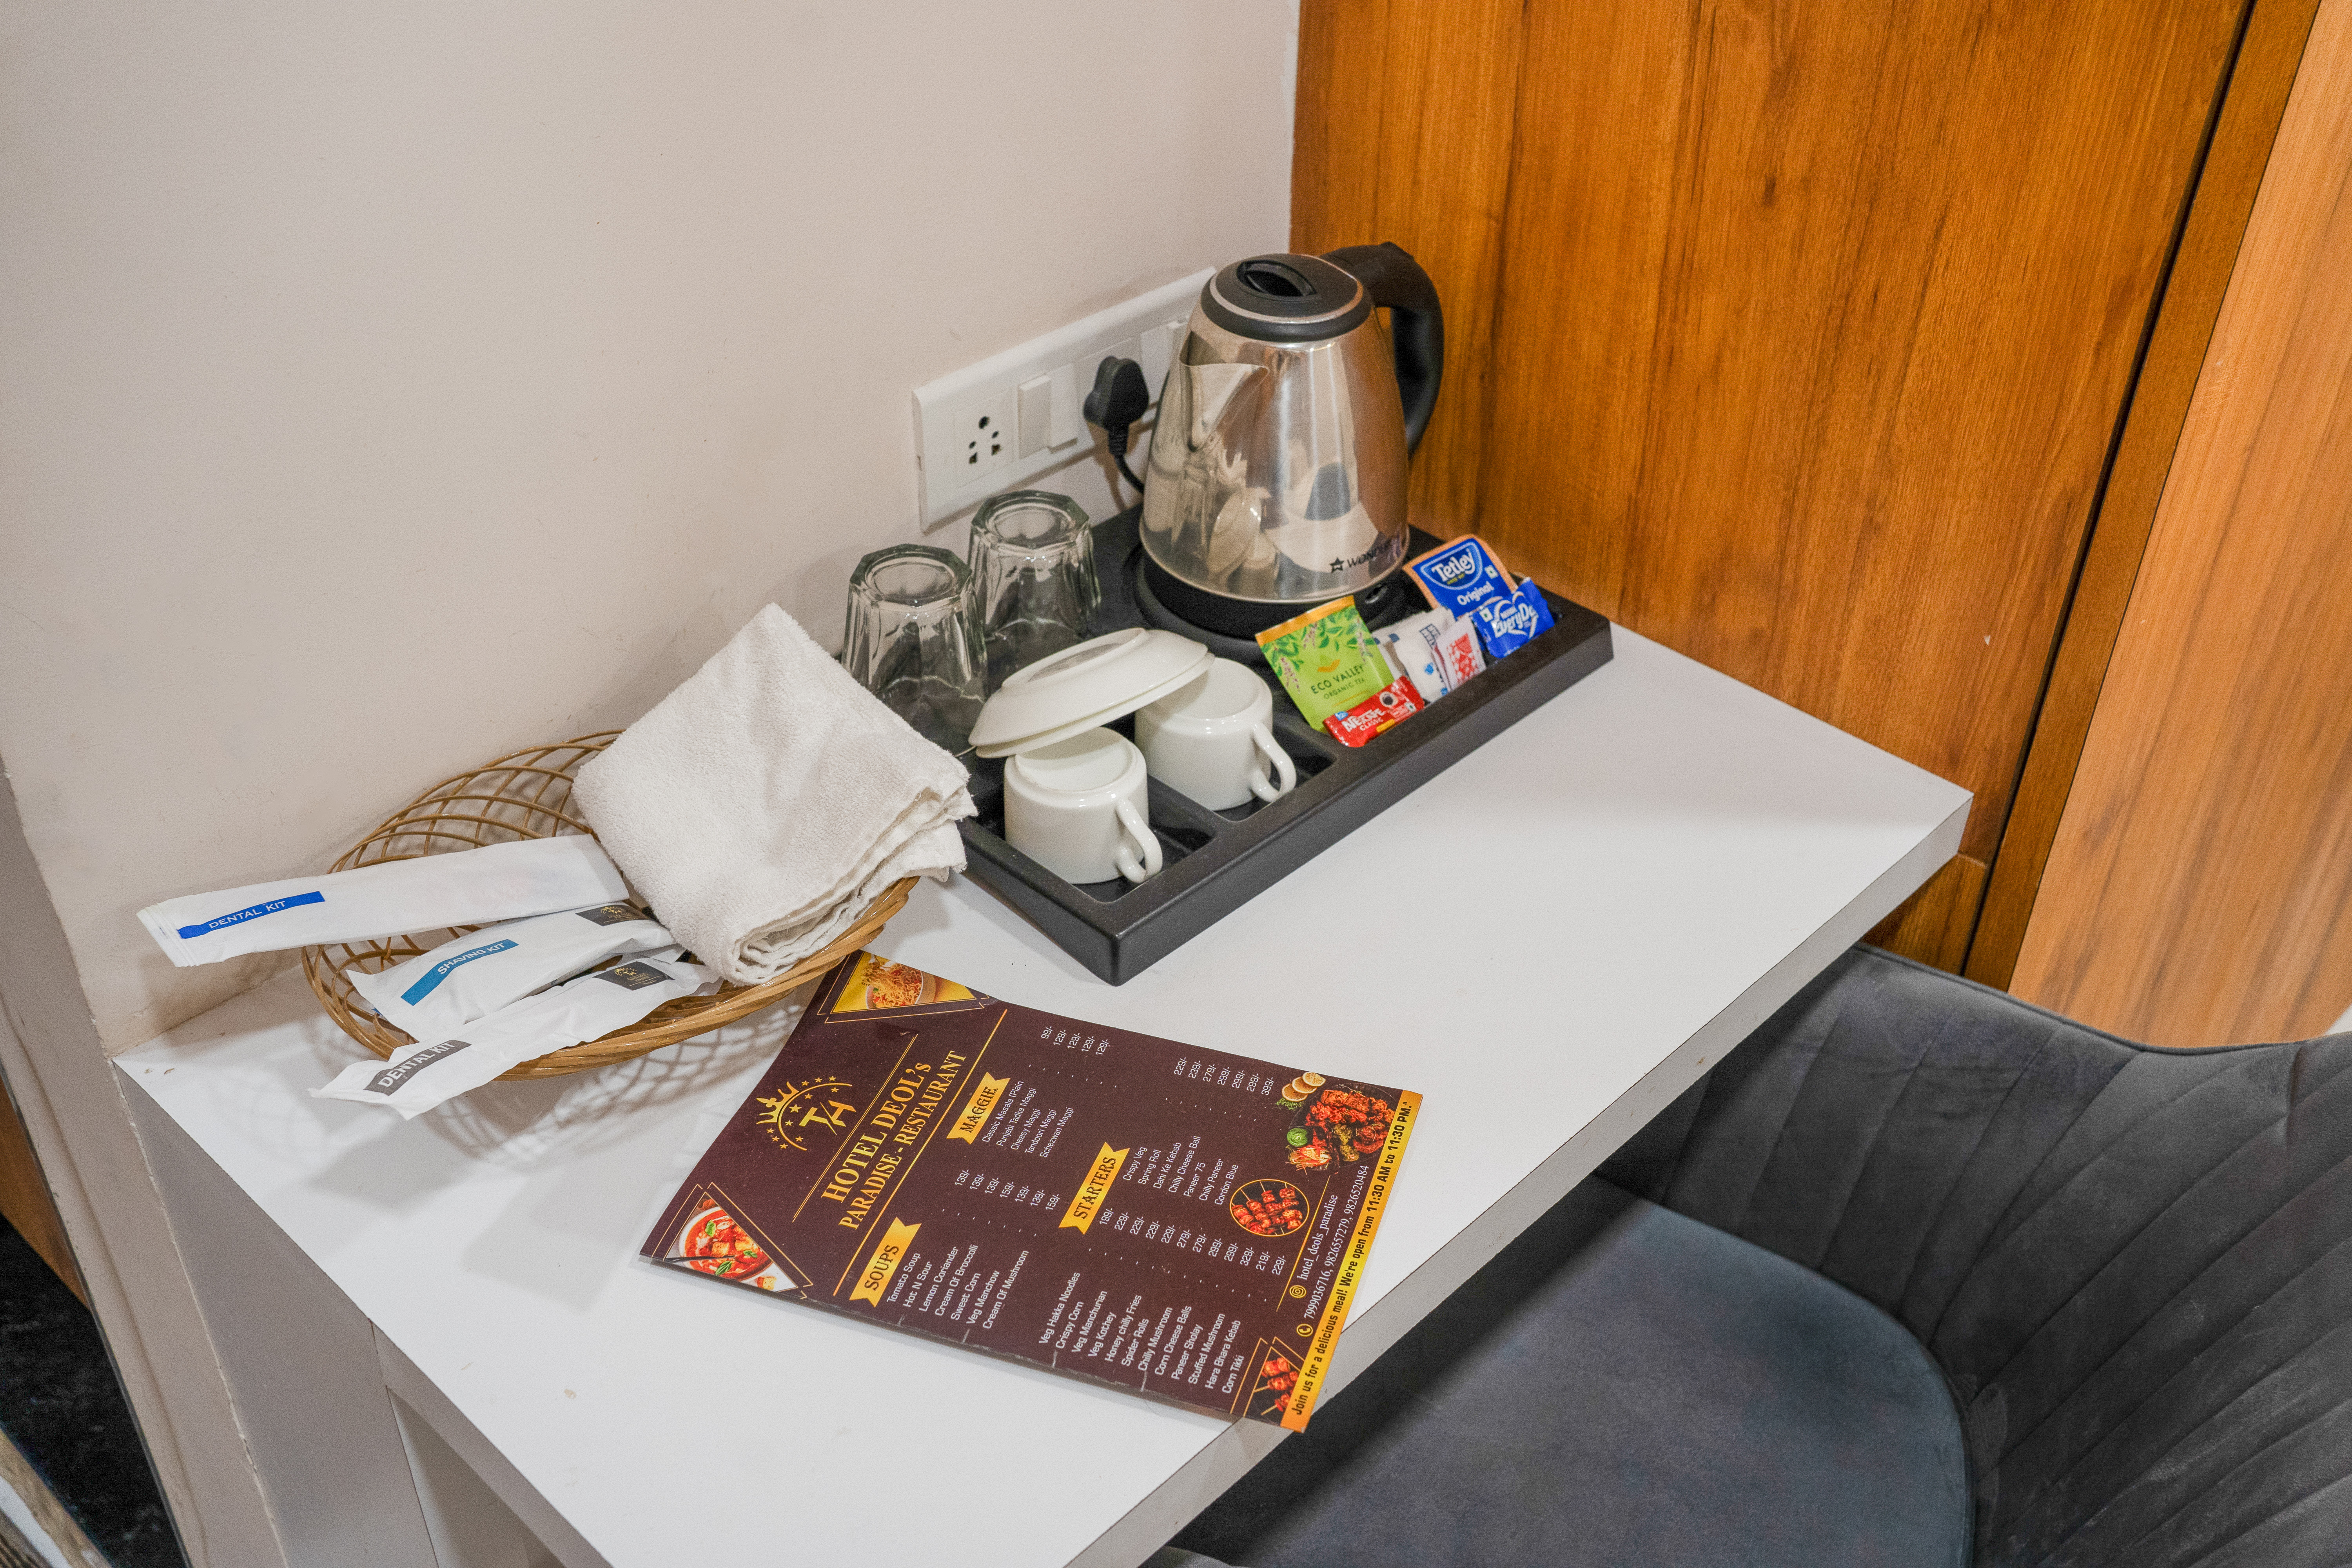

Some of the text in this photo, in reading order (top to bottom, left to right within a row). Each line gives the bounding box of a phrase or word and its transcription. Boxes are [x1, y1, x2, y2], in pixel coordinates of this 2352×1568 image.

[1432, 548, 1475, 582] Tetley
[1457, 581, 1494, 605] Original
[1311, 664, 1365, 694] ECO VALLEY
[1324, 682, 1353, 699] ORGANIC
[209, 901, 286, 929] DENTAL KIT
[437, 943, 505, 974] SHAVING KIT
[377, 1042, 455, 1087] DENTAL KIT
[959, 1086, 998, 1133] MAGGIE
[981, 1025, 1053, 1142] Classic Masala (Plain 99/-
[995, 1029, 1067, 1146] Punjabi Tadka Maggi 129/-
[1010, 1032, 1081, 1150] Cheesy Maggi 129/-
[1024, 1035, 1095, 1153] Tandoori Maggi 129/-
[1039, 1038, 1109, 1158] Schezwan Maggi 129/-
[1122, 1057, 1187, 1180] Crispy Veg 229/-
[1137, 1060, 1202, 1185] Spring Roll 239/-
[1152, 1063, 1216, 1189] Dahi Ke Kebab 279/-
[820, 1062, 931, 1203] HOTEL DEOL's
[838, 1153, 902, 1230] PARADISE
[893, 1050, 966, 1146] RESTAURANT
[1073, 1156, 1116, 1220] STARTERS
[1168, 1066, 1231, 1193] Chilly Cheese Ball 299/-
[1183, 1069, 1245, 1197] Paneer 75 299/-
[1198, 1073, 1260, 1201] Chilly Paneer 299/-
[1214, 1076, 1274, 1205] Cordon Blue 399/-
[1376, 1165, 1391, 1183] AM
[1383, 1154, 1395, 1164] to
[1387, 1124, 1405, 1151] 11:30
[886, 1169, 970, 1302] Tomato Soup 139/-
[902, 1173, 985, 1307] Hot N Sour 139/-
[918, 1178, 1000, 1312] Lemon Coriander 139/-
[934, 1181, 1015, 1316] Cream Of Broccolli 159/-
[950, 1185, 1030, 1320] Sweet Corn 139/-
[965, 1189, 1045, 1324] Veg Manchow 139/-
[1296, 1194, 1338, 1280] hotel_deols_paradise
[1303, 1165, 1369, 1319] 7999036716, 9826557279, 9826520484
[1352, 1238, 1366, 1259] open
[1357, 1216, 1374, 1236] from
[1366, 1184, 1385, 1212] 11:30
[864, 1244, 899, 1291] SOUPS
[982, 1193, 1060, 1329] Cream Of Mushroom 159/-
[1038, 1207, 1114, 1343] Veg Hakka Noodles 199/-
[1055, 1212, 1129, 1349] Crispy Corn 229/-
[1071, 1216, 1145, 1352] Veg Manchurian 229/-
[1087, 1220, 1160, 1356] Veg Kothey 229/-
[1104, 1225, 1176, 1362] Honey chilly Fries 229/-
[1121, 1229, 1191, 1366] Spider Rolls 279/-
[1137, 1233, 1207, 1371] Chilly Mushroom 279/-
[1154, 1238, 1223, 1375] Corn Cheese Balls 299/-
[1171, 1242, 1238, 1380] Paneer Sholay 299/-
[1187, 1247, 1254, 1384] Stuffed Mushroom 329/-
[1204, 1251, 1270, 1389] Hara Bhara Kebab 219/-
[1332, 1289, 1348, 1313] meal!
[1339, 1261, 1358, 1286] We're
[1221, 1255, 1286, 1394] Corn Tikki 229/-
[1302, 1380, 1313, 1392] us
[1305, 1364, 1319, 1378] for
[1314, 1315, 1338, 1354] delicious
[1291, 1394, 1308, 1415] Join
